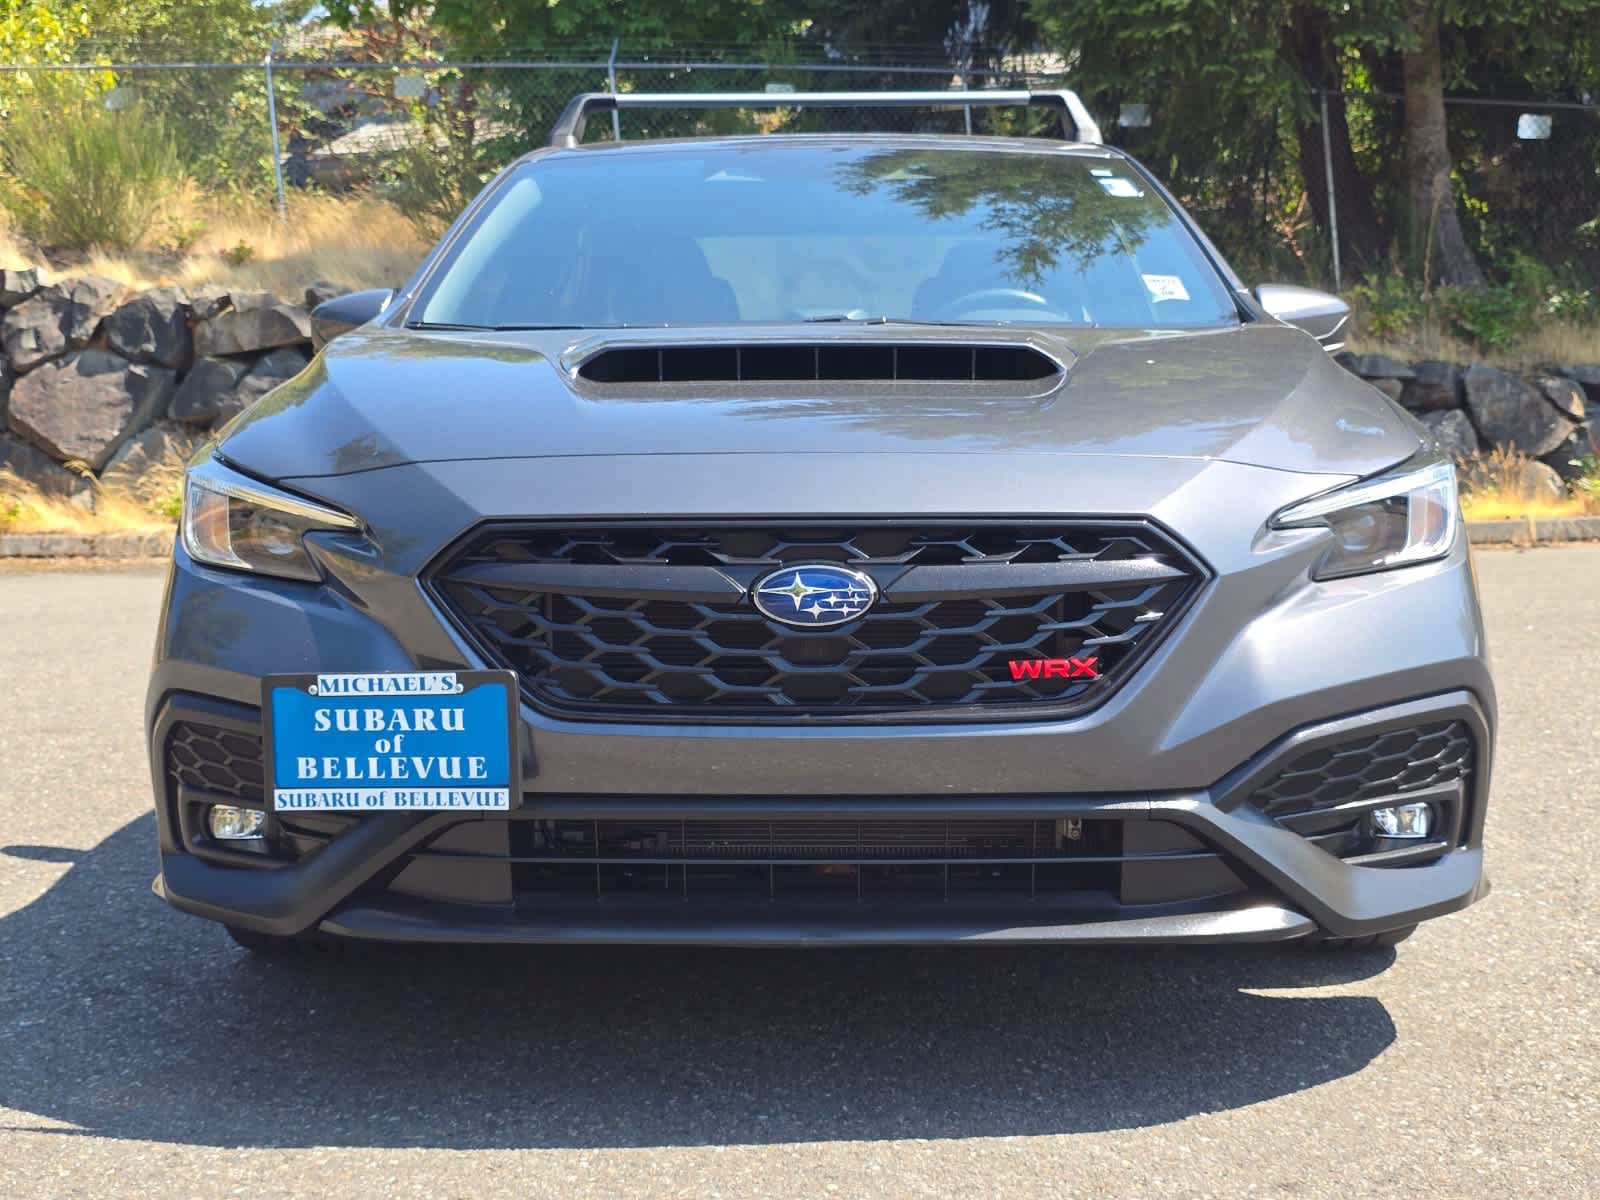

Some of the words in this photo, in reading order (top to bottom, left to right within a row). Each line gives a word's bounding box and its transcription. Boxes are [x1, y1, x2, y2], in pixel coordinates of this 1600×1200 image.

[1008, 656, 1098, 680] WRX
[320, 676, 454, 693] MICHAEL'S
[314, 708, 465, 732] SUBARU
[374, 734, 405, 754] of
[296, 757, 488, 780] BELLEVUE
[278, 791, 360, 809] SUBARU
[366, 790, 385, 807] of
[394, 790, 506, 807] BELLEVUE
